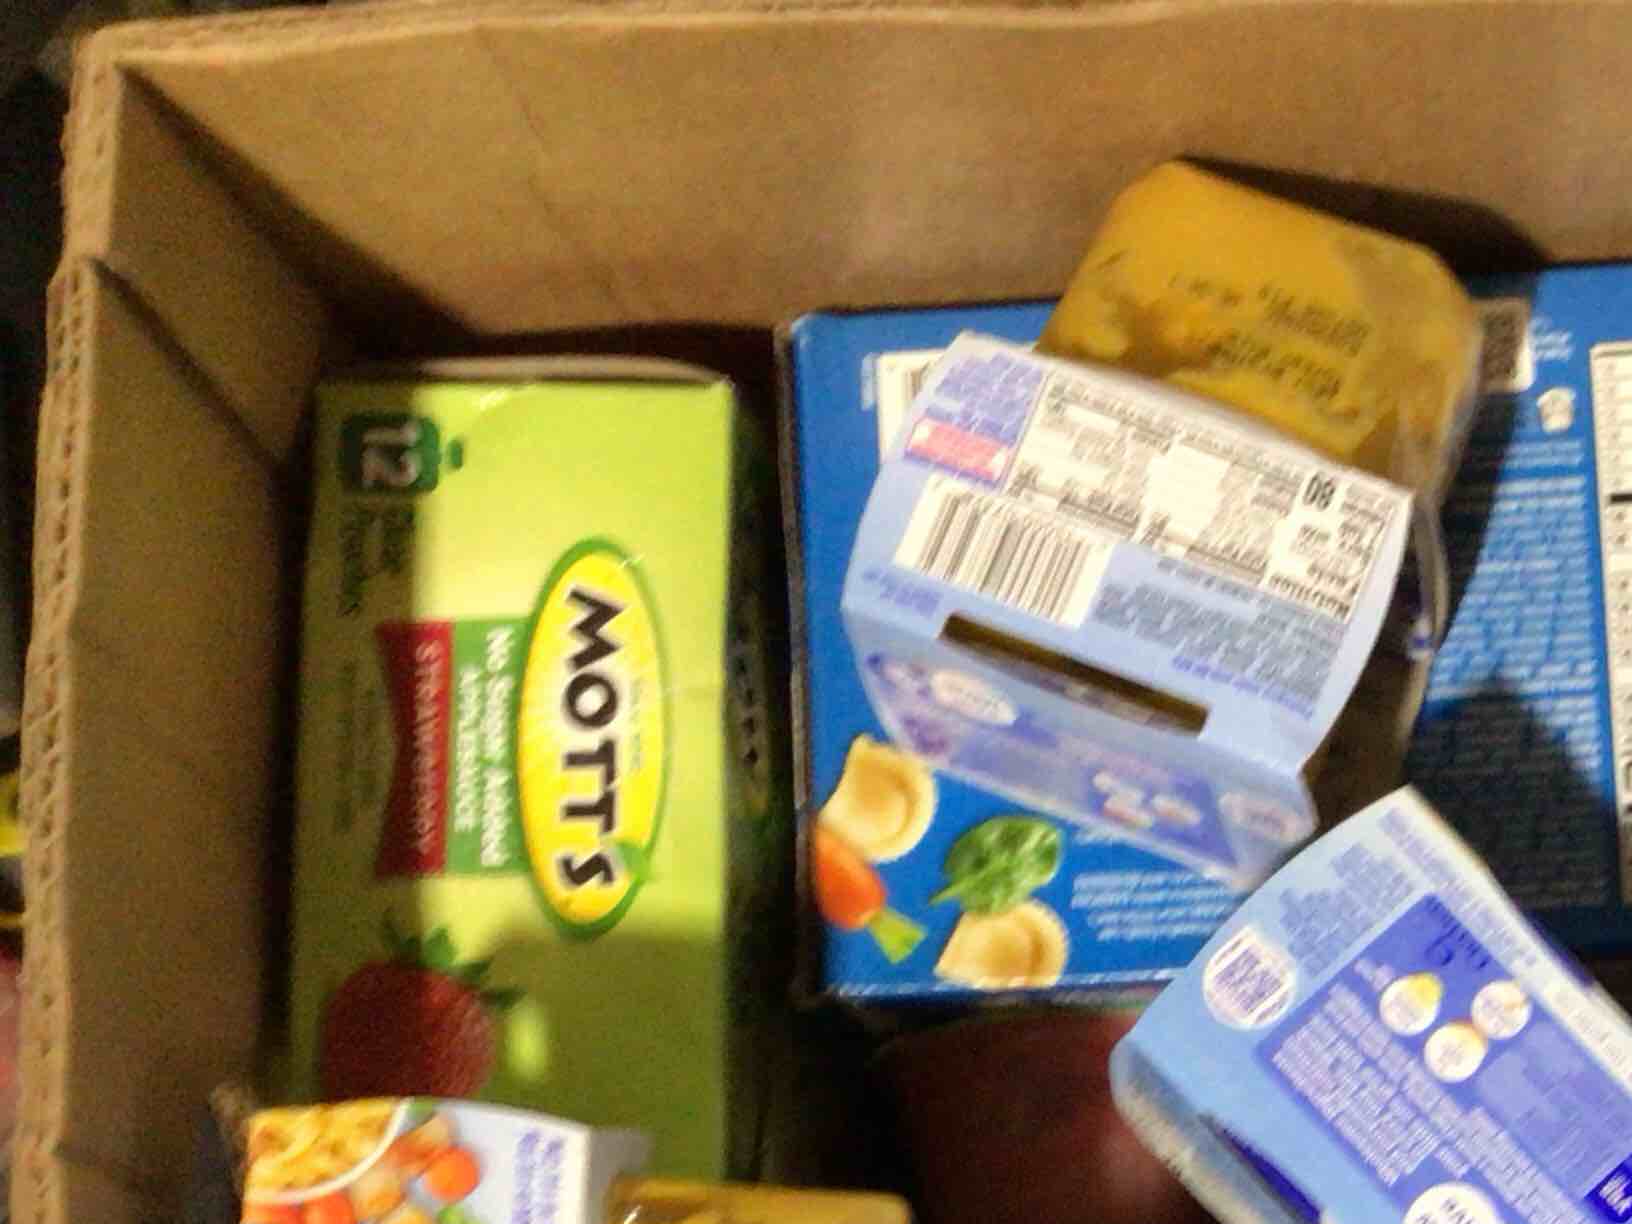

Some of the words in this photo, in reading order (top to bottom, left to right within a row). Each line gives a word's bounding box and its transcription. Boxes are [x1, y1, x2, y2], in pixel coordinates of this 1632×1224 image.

[360, 422, 420, 487] 12
[1299, 471, 1339, 513] 80
[482, 628, 511, 671] No
